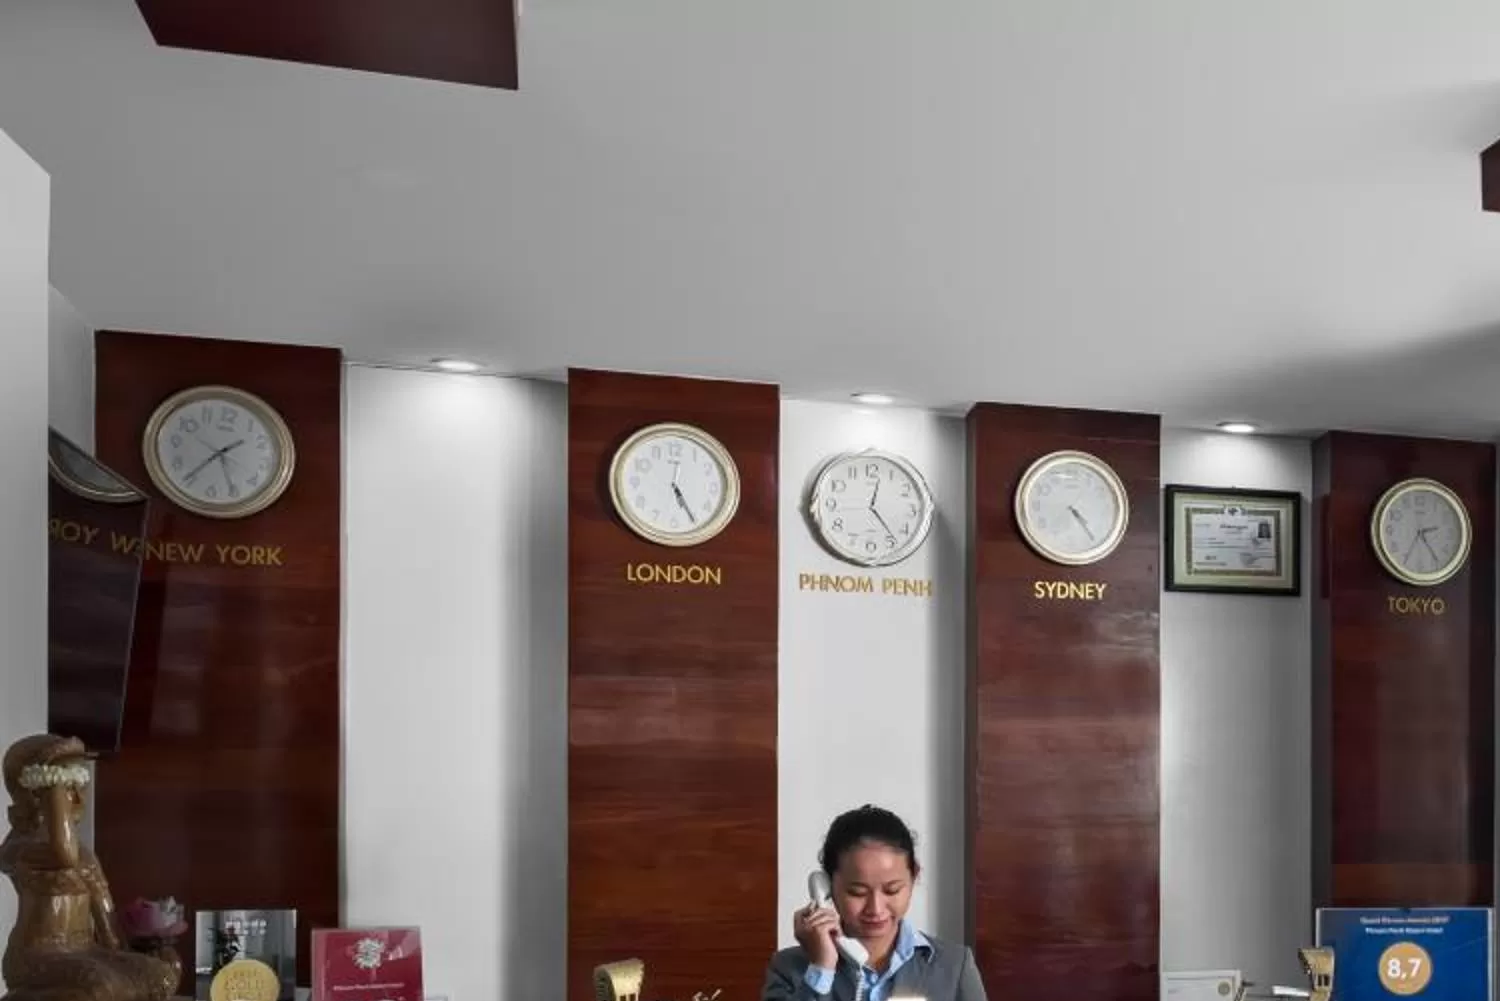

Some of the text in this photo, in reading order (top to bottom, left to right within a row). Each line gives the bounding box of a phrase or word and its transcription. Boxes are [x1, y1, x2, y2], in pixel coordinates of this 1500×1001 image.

[145, 541, 283, 566] NEW YORK
[627, 563, 721, 585] LONDON
[799, 573, 933, 597] PHNOM PENH
[1034, 581, 1107, 599] SYDNEY
[1387, 595, 1445, 616] TOKYO
